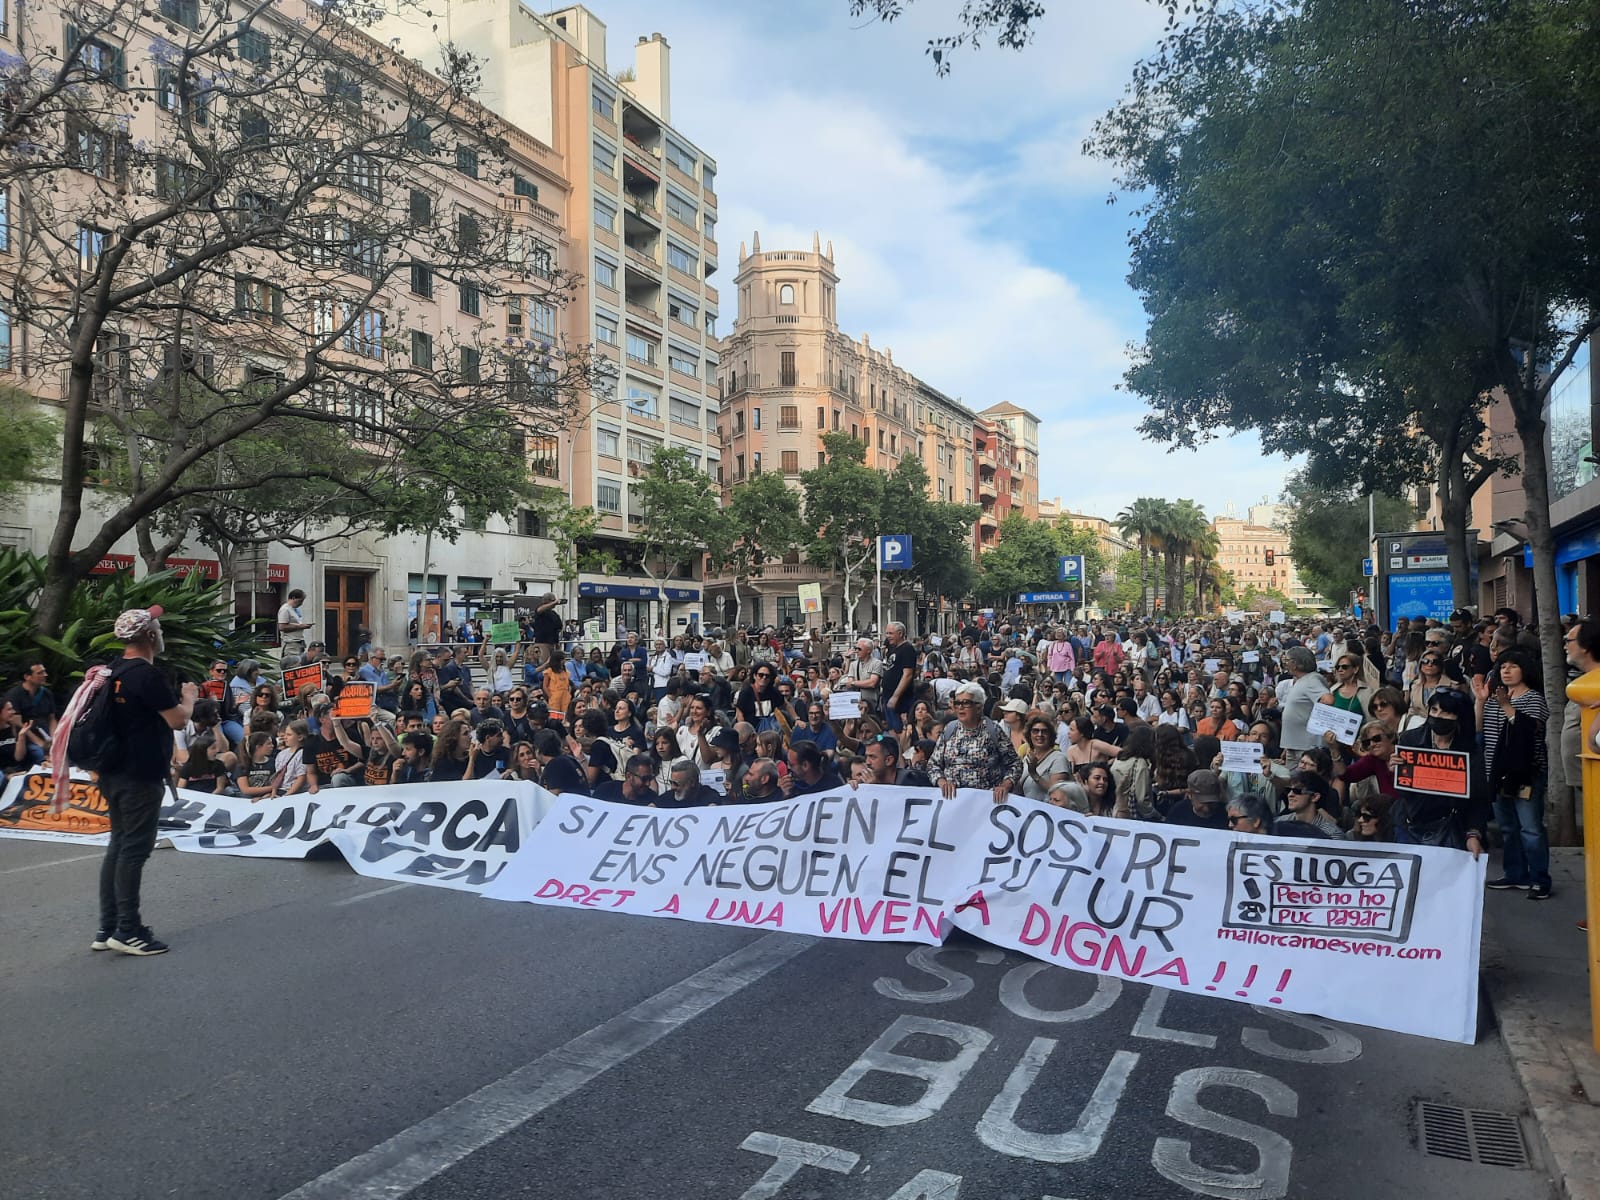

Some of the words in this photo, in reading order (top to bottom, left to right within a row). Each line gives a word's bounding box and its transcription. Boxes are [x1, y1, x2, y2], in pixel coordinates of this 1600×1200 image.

[885, 541, 902, 560] P
[1392, 543, 1401, 552] P
[1064, 560, 1077, 575] P
[1033, 593, 1064, 601] ENTRADA
[1399, 751, 1414, 764] SE
[1416, 752, 1466, 770] ALQUILA
[559, 805, 609, 838] SI
[613, 814, 700, 848] ENS
[707, 797, 878, 846] NEGUEN
[895, 798, 956, 852] EL
[989, 804, 1201, 900] SOSTRE
[1239, 852, 1284, 882] ES
[1293, 857, 1404, 890] LLOGA
[589, 849, 678, 886] ENS
[683, 845, 869, 897] NEGUEN
[882, 850, 945, 906] EL
[967, 855, 1185, 952] FUTUR
[1277, 886, 1323, 905] Però
[1327, 892, 1352, 905] no
[1359, 889, 1386, 907] ho
[534, 878, 637, 907] DRET
[653, 893, 681, 914] A
[705, 897, 784, 928] UNA
[1018, 902, 1190, 986] DIGNA
[1217, 928, 1442, 960] mallorcanoesven.com
[804, 1013, 1299, 1200] BUS
